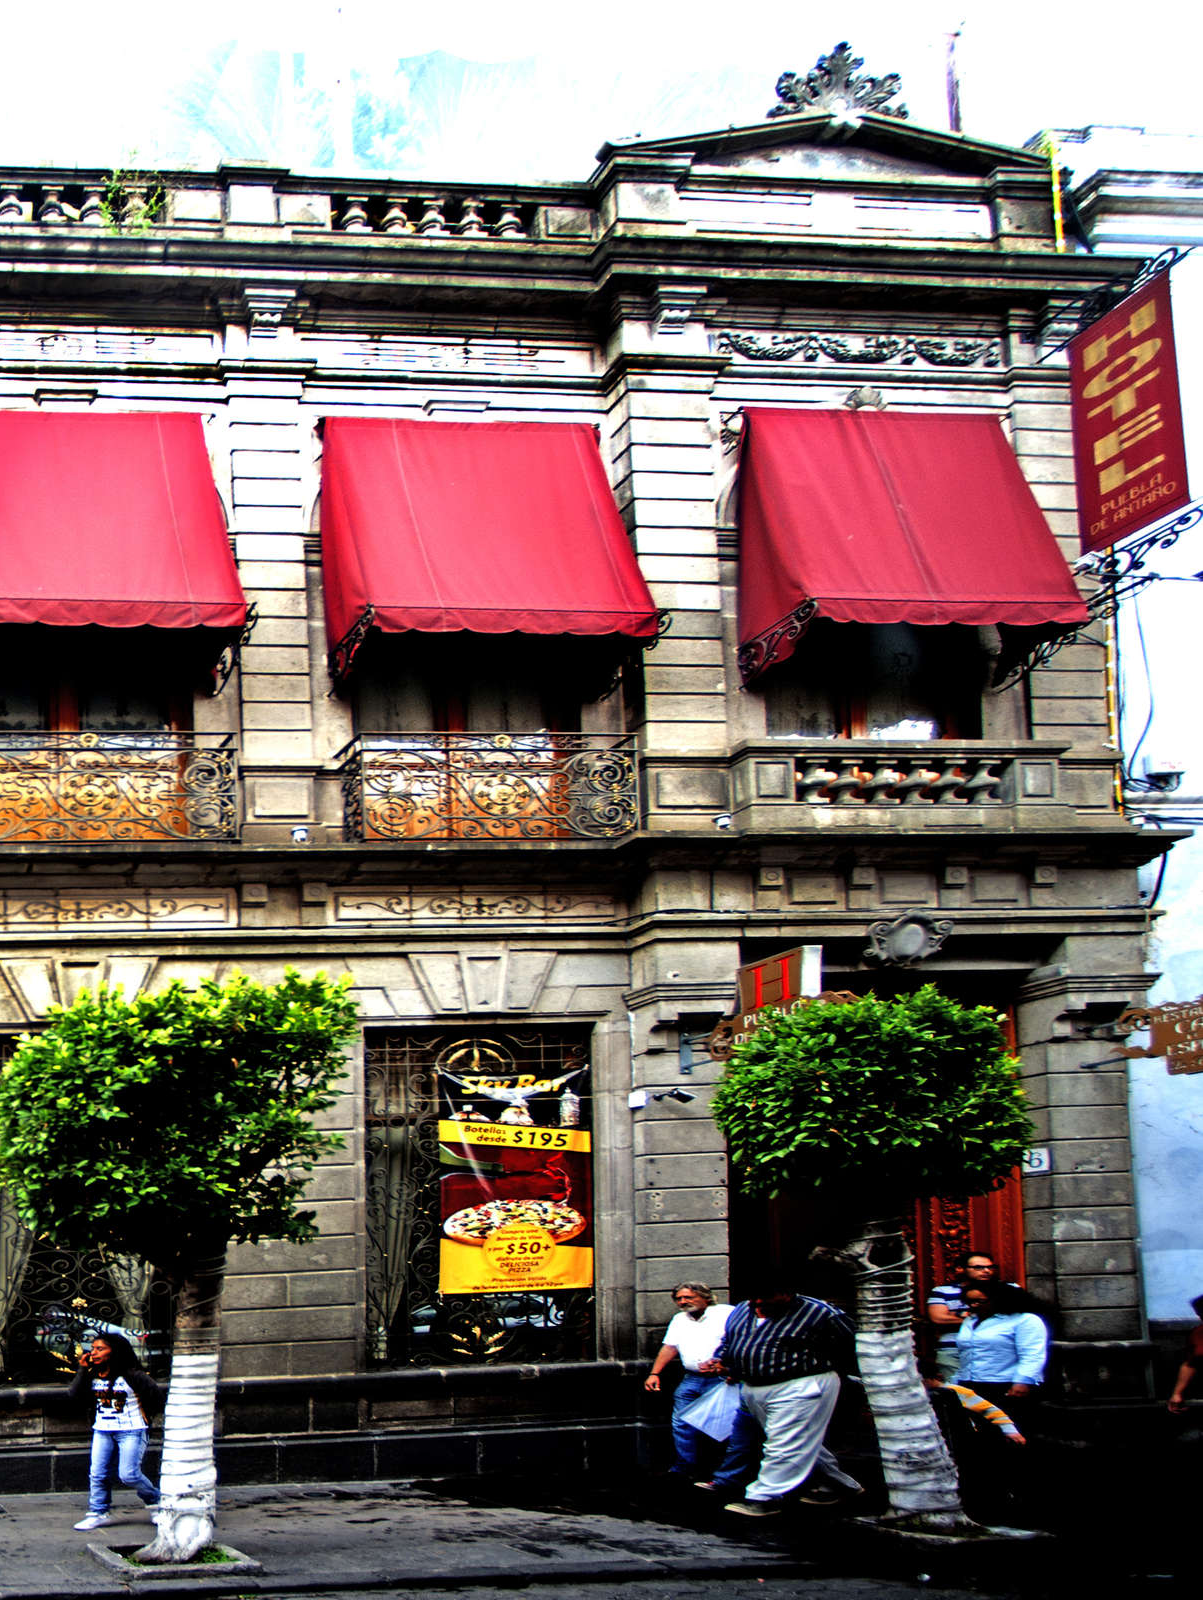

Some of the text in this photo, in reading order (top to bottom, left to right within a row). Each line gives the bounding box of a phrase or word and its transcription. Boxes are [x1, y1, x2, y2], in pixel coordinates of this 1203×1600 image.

[1082, 299, 1166, 496] HOTEL
[1101, 472, 1162, 515] PUEBLA
[1090, 517, 1110, 536] DE
[746, 953, 799, 1010] H
[476, 1135, 507, 1143] desde
[512, 1130, 568, 1147] $195
